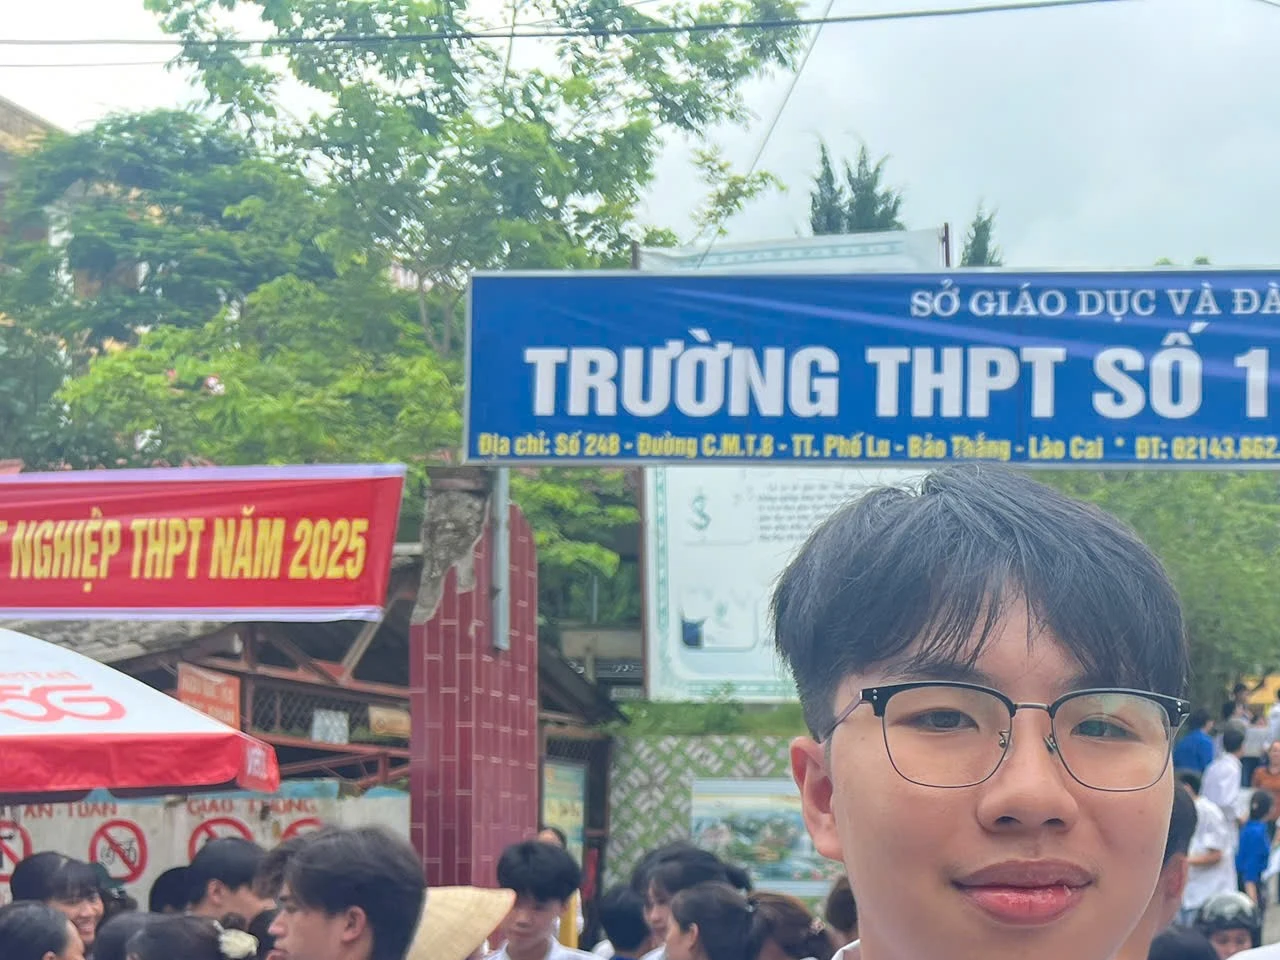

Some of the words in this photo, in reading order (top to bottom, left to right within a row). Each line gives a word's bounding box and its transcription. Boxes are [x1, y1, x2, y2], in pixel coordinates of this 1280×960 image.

[910, 278, 960, 317] SỞ
[968, 282, 1067, 316] GIÁO
[1076, 289, 1156, 323] DỤC
[1165, 281, 1222, 316] VÀ
[524, 328, 840, 418] TRƯỜNG
[866, 347, 1066, 418] THPT
[1092, 322, 1209, 419] SỐ
[1234, 349, 1268, 418] 1
[554, 430, 582, 456] Số
[823, 431, 864, 459] Phố
[866, 435, 890, 458] Lu
[1028, 434, 1066, 460] Lào
[10, 506, 121, 593] NGHIỆP
[130, 518, 205, 579] THPT
[208, 506, 286, 580] NĂM
[288, 518, 369, 580] 2025
